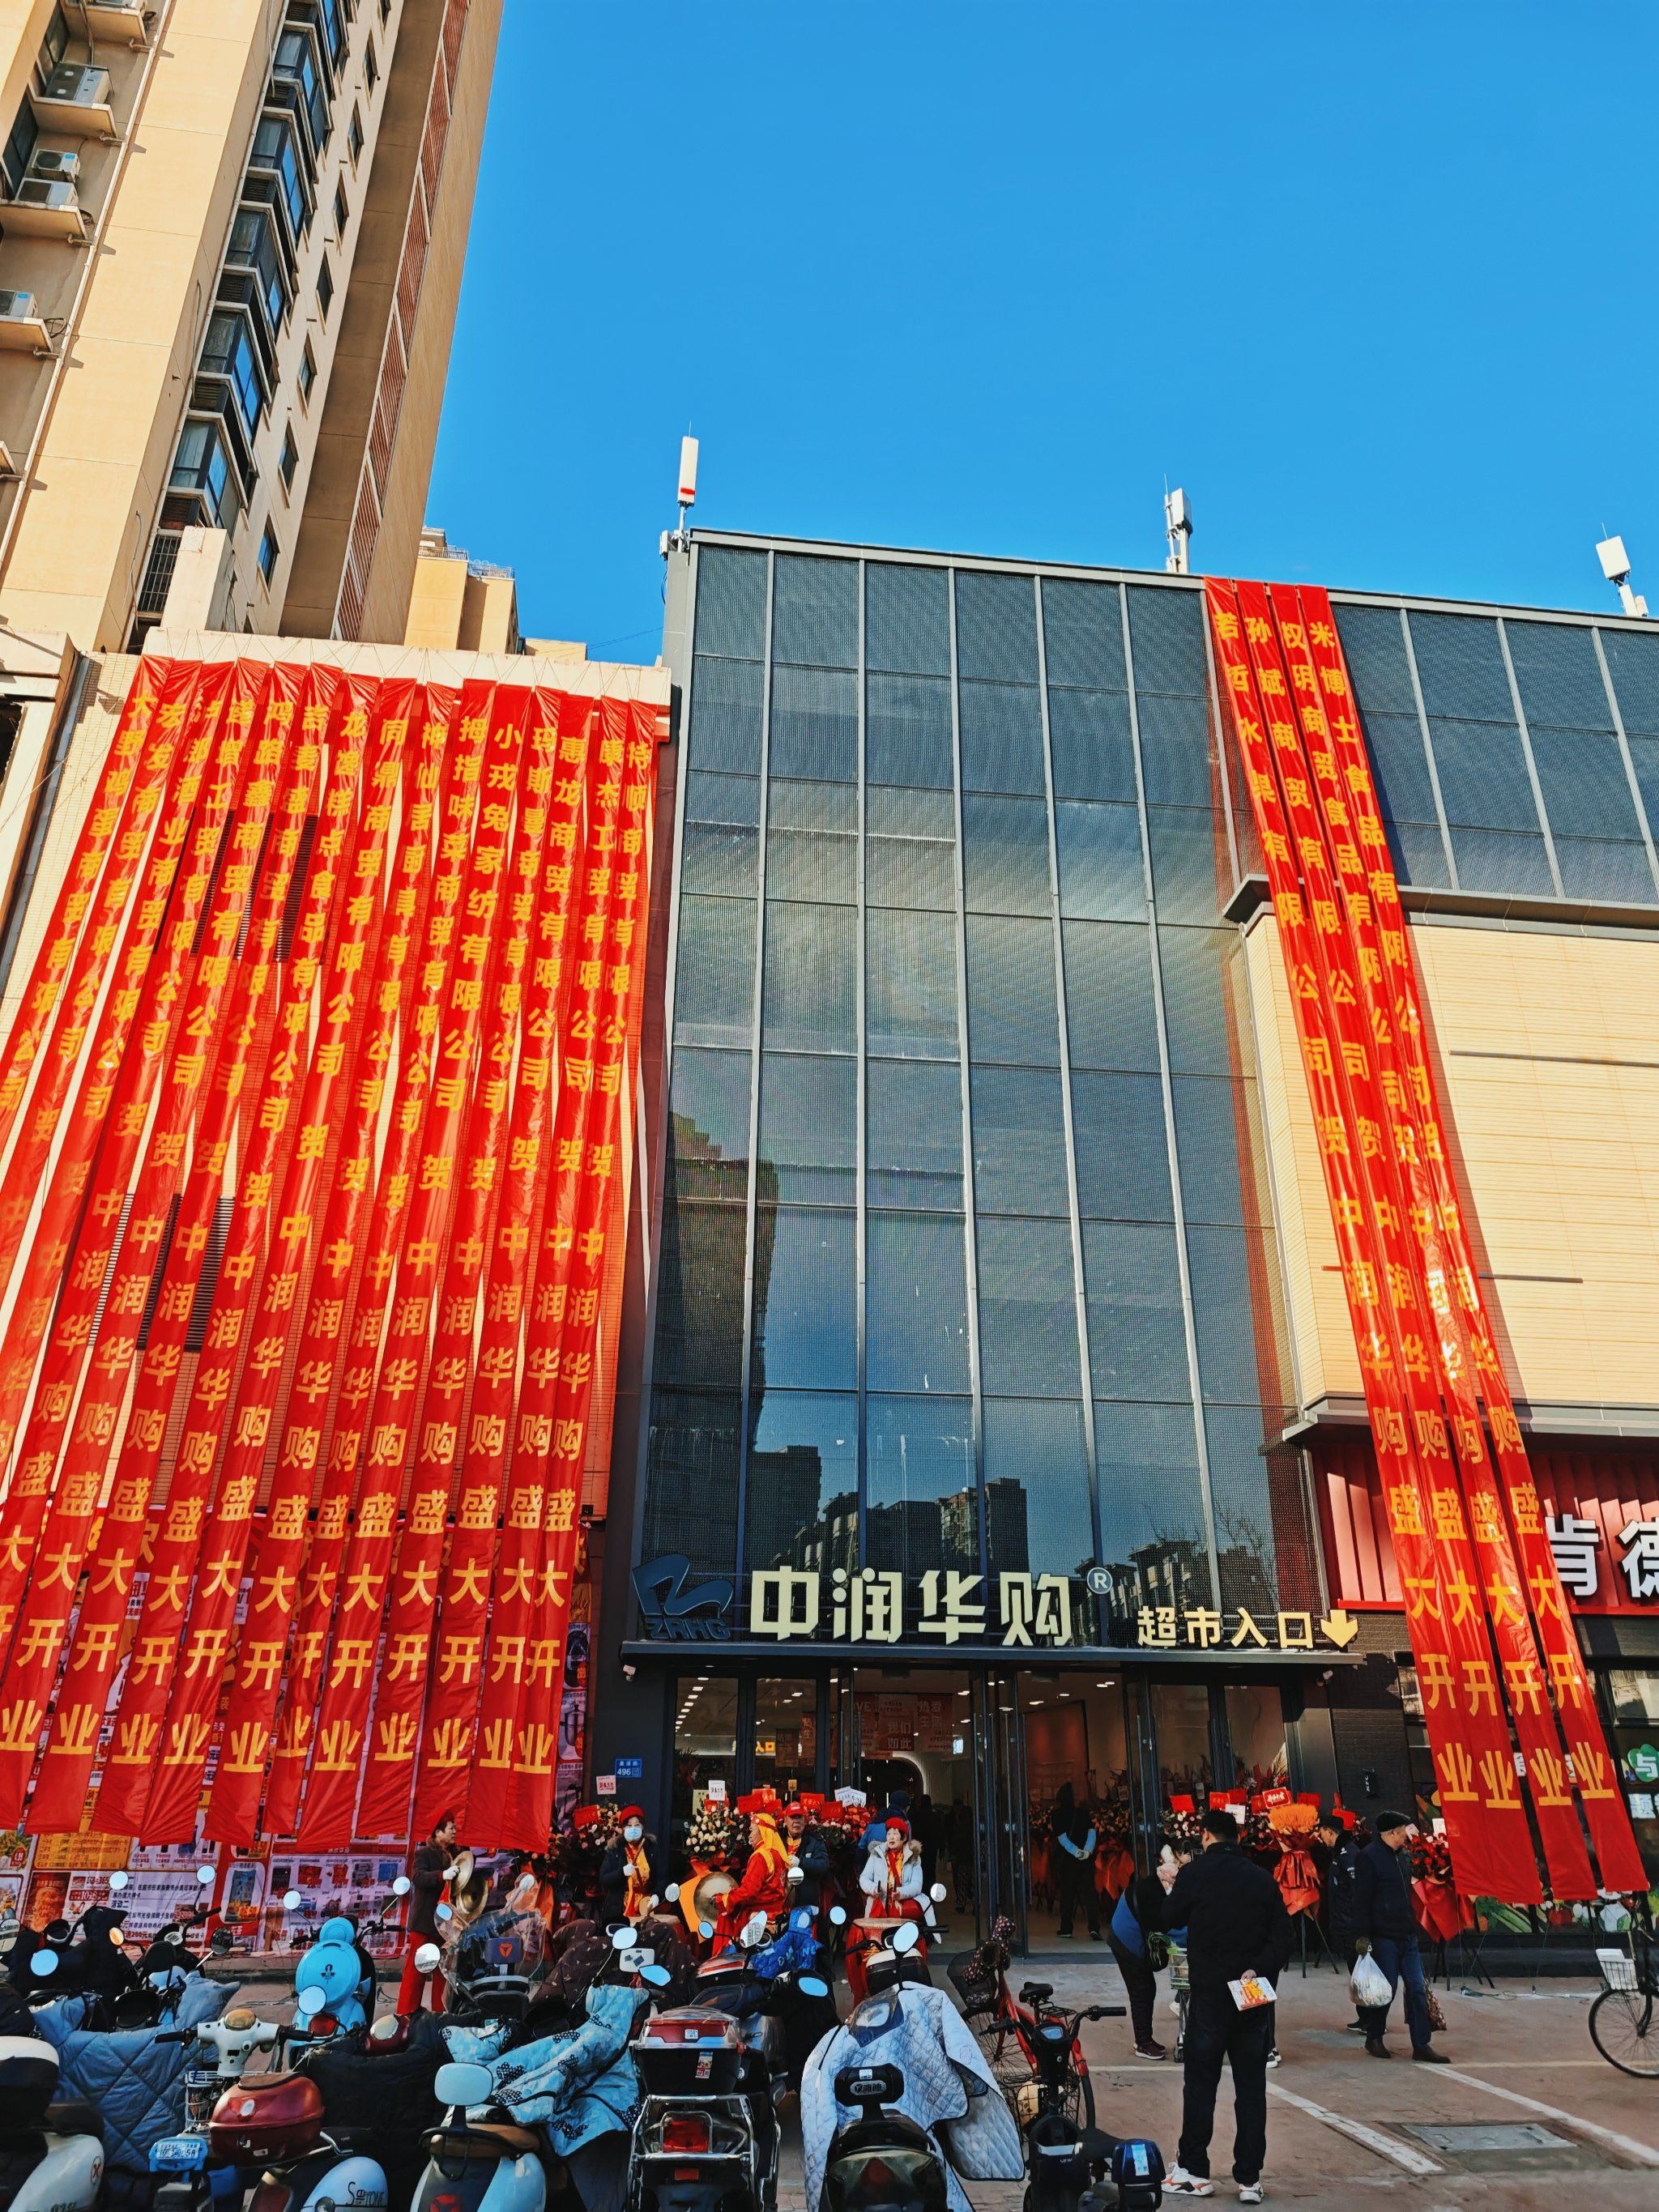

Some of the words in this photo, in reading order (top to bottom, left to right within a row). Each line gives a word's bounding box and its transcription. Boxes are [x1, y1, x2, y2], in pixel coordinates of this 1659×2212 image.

[750, 1565, 1071, 1647] 中润华购
[1137, 1606, 1316, 1649] 超市入口
